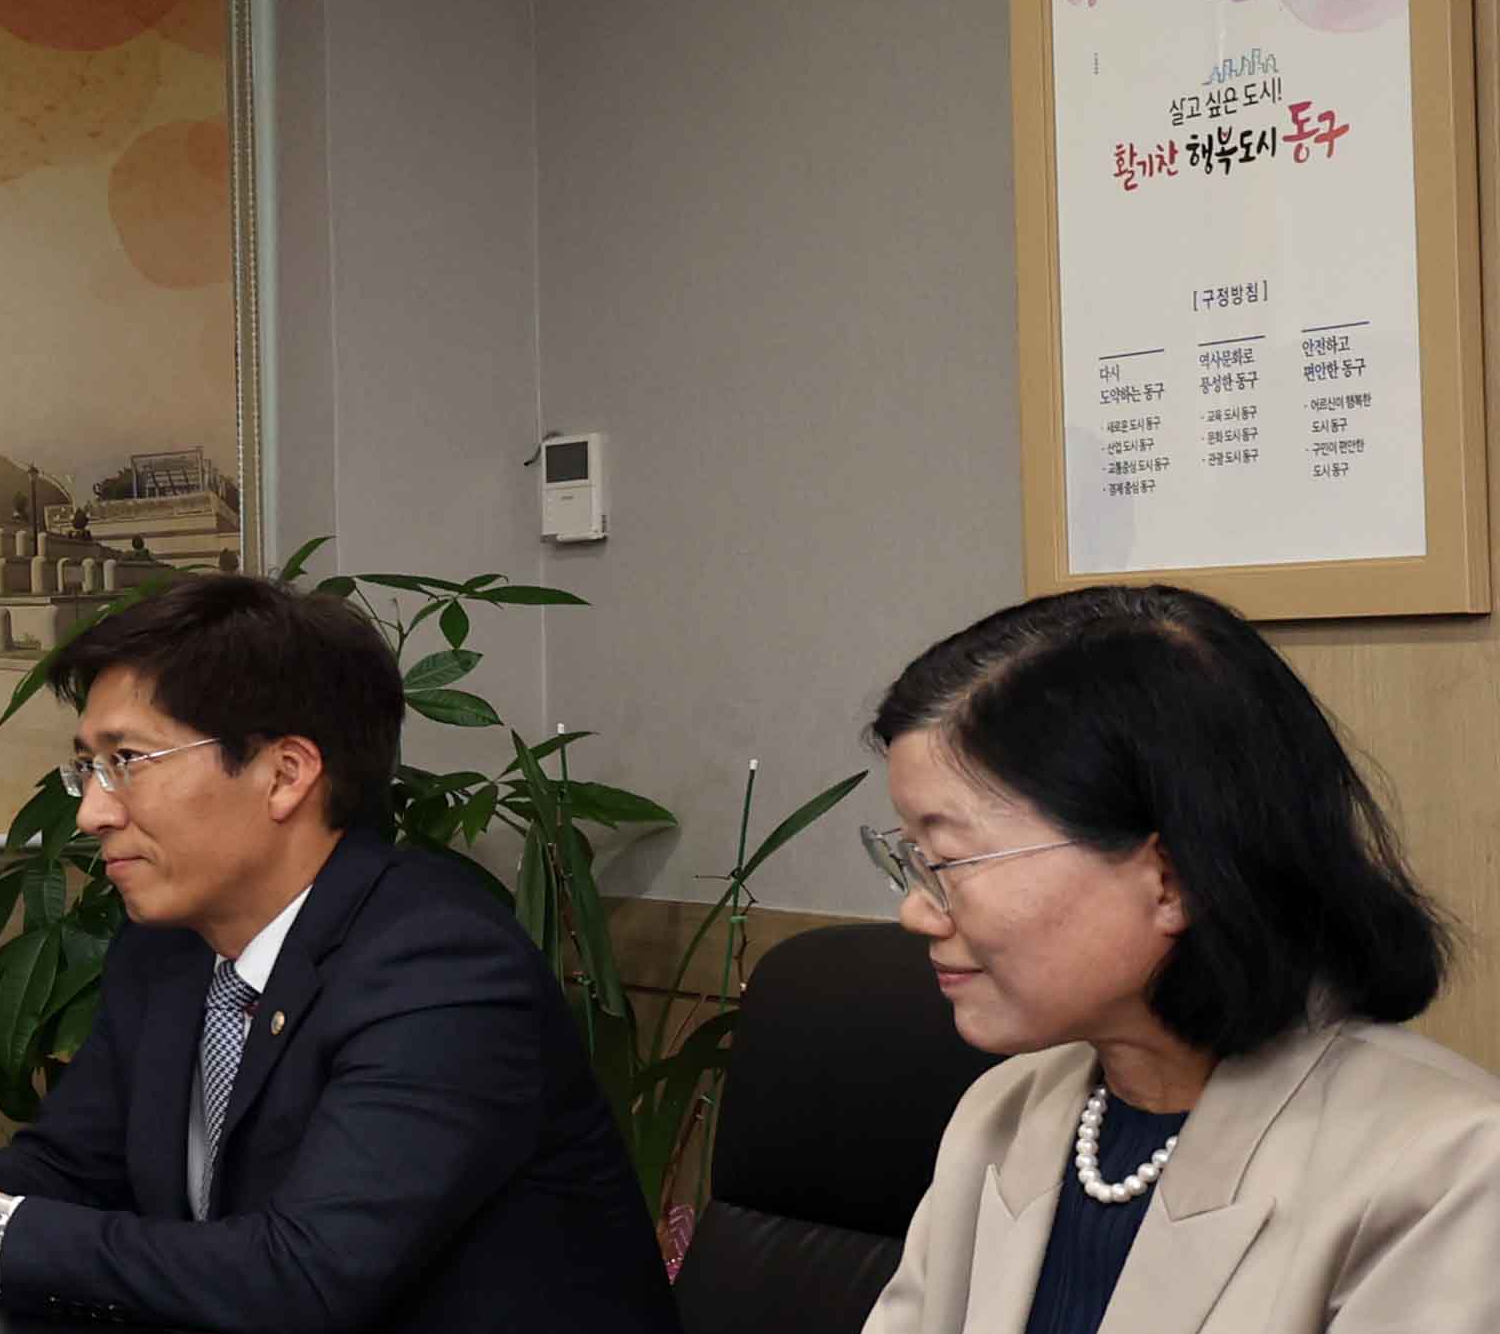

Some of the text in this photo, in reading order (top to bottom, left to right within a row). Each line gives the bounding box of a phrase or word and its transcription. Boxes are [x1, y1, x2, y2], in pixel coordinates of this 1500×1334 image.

[1168, 77, 1283, 127] 살고 싶은 도시!
[1113, 100, 1350, 192] 활기찬 행복도시 동구
[1301, 335, 1350, 358] 안전하고
[1199, 347, 1255, 370] 역사문화로
[1303, 357, 1367, 382] 편안한 동구
[1099, 363, 1120, 384] 다시
[1235, 370, 1258, 390] 동구
[1143, 382, 1164, 402] 동구
